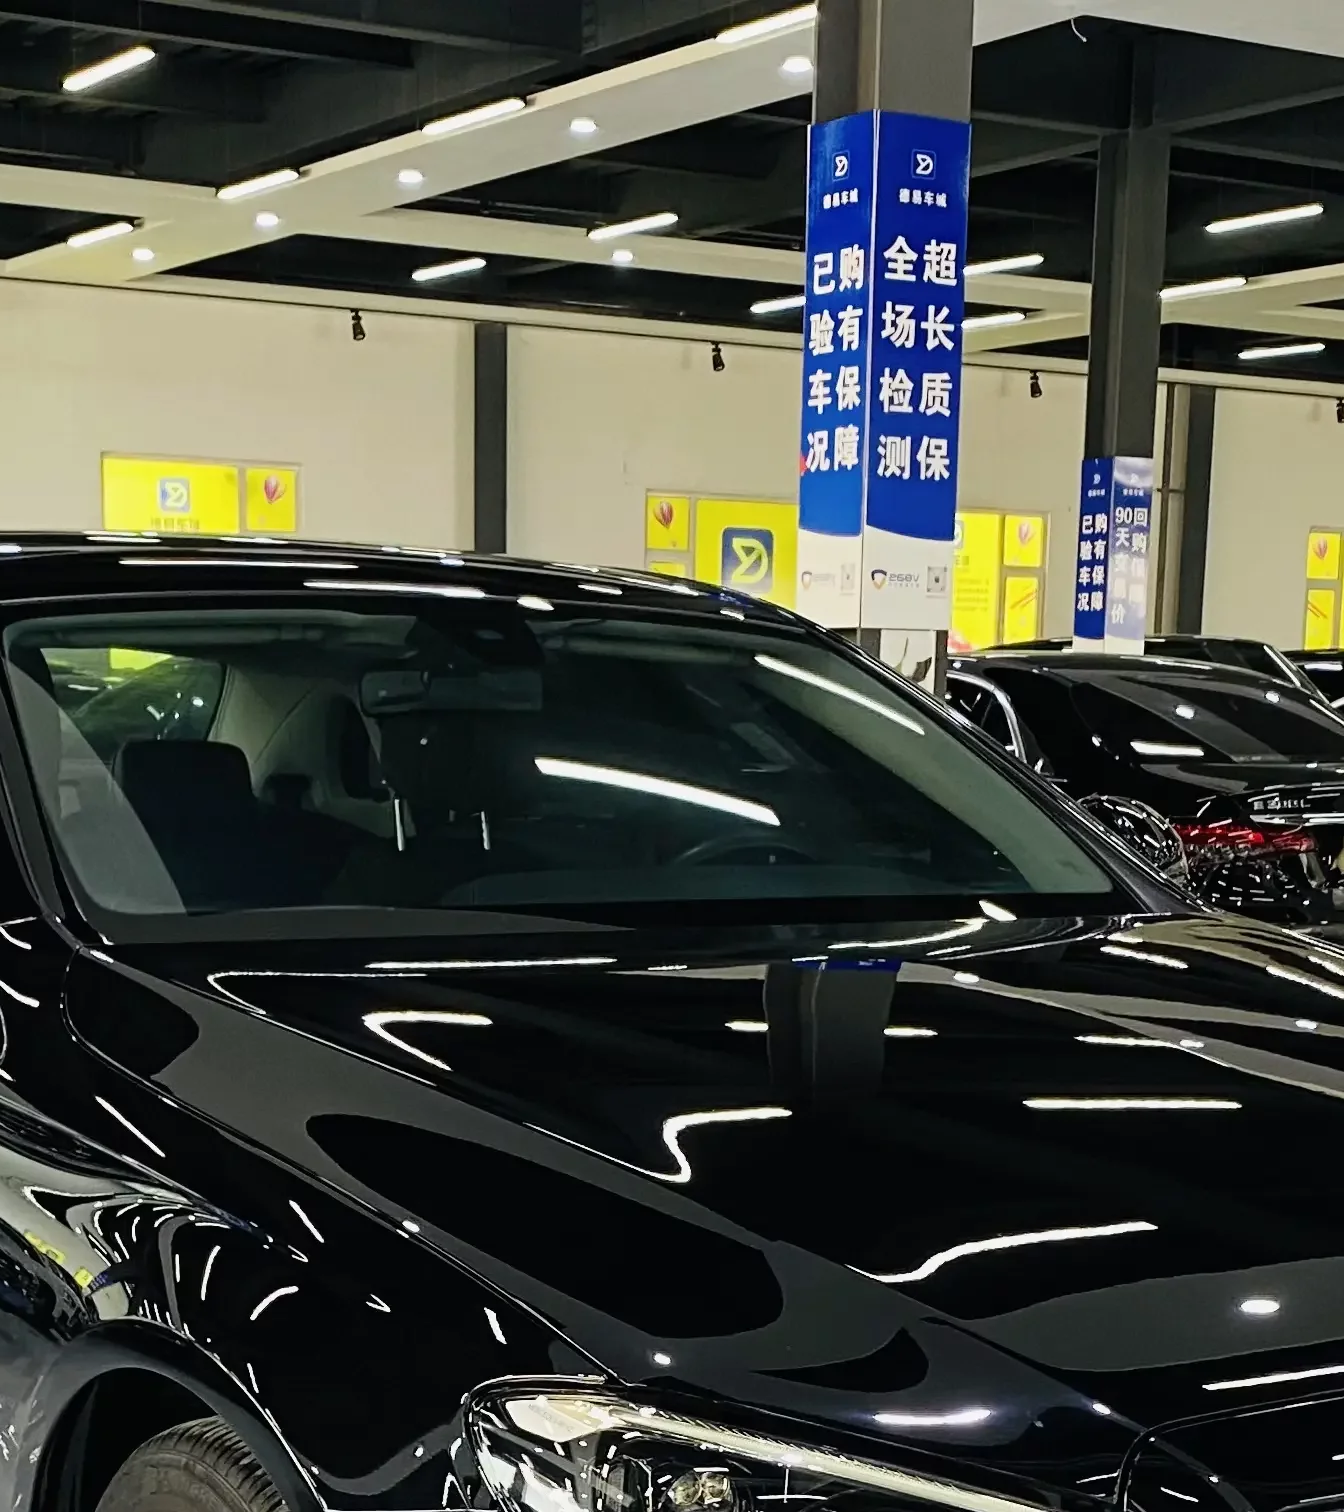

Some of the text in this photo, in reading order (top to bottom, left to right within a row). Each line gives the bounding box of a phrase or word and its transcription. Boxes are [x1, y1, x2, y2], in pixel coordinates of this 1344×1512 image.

[806, 252, 836, 472] 已验车况
[833, 243, 865, 471] 购有保障
[875, 235, 919, 480] 全场检测
[915, 239, 959, 481] 超长质保
[1077, 515, 1093, 611] 已验车况
[1091, 513, 1107, 612] 购有保障
